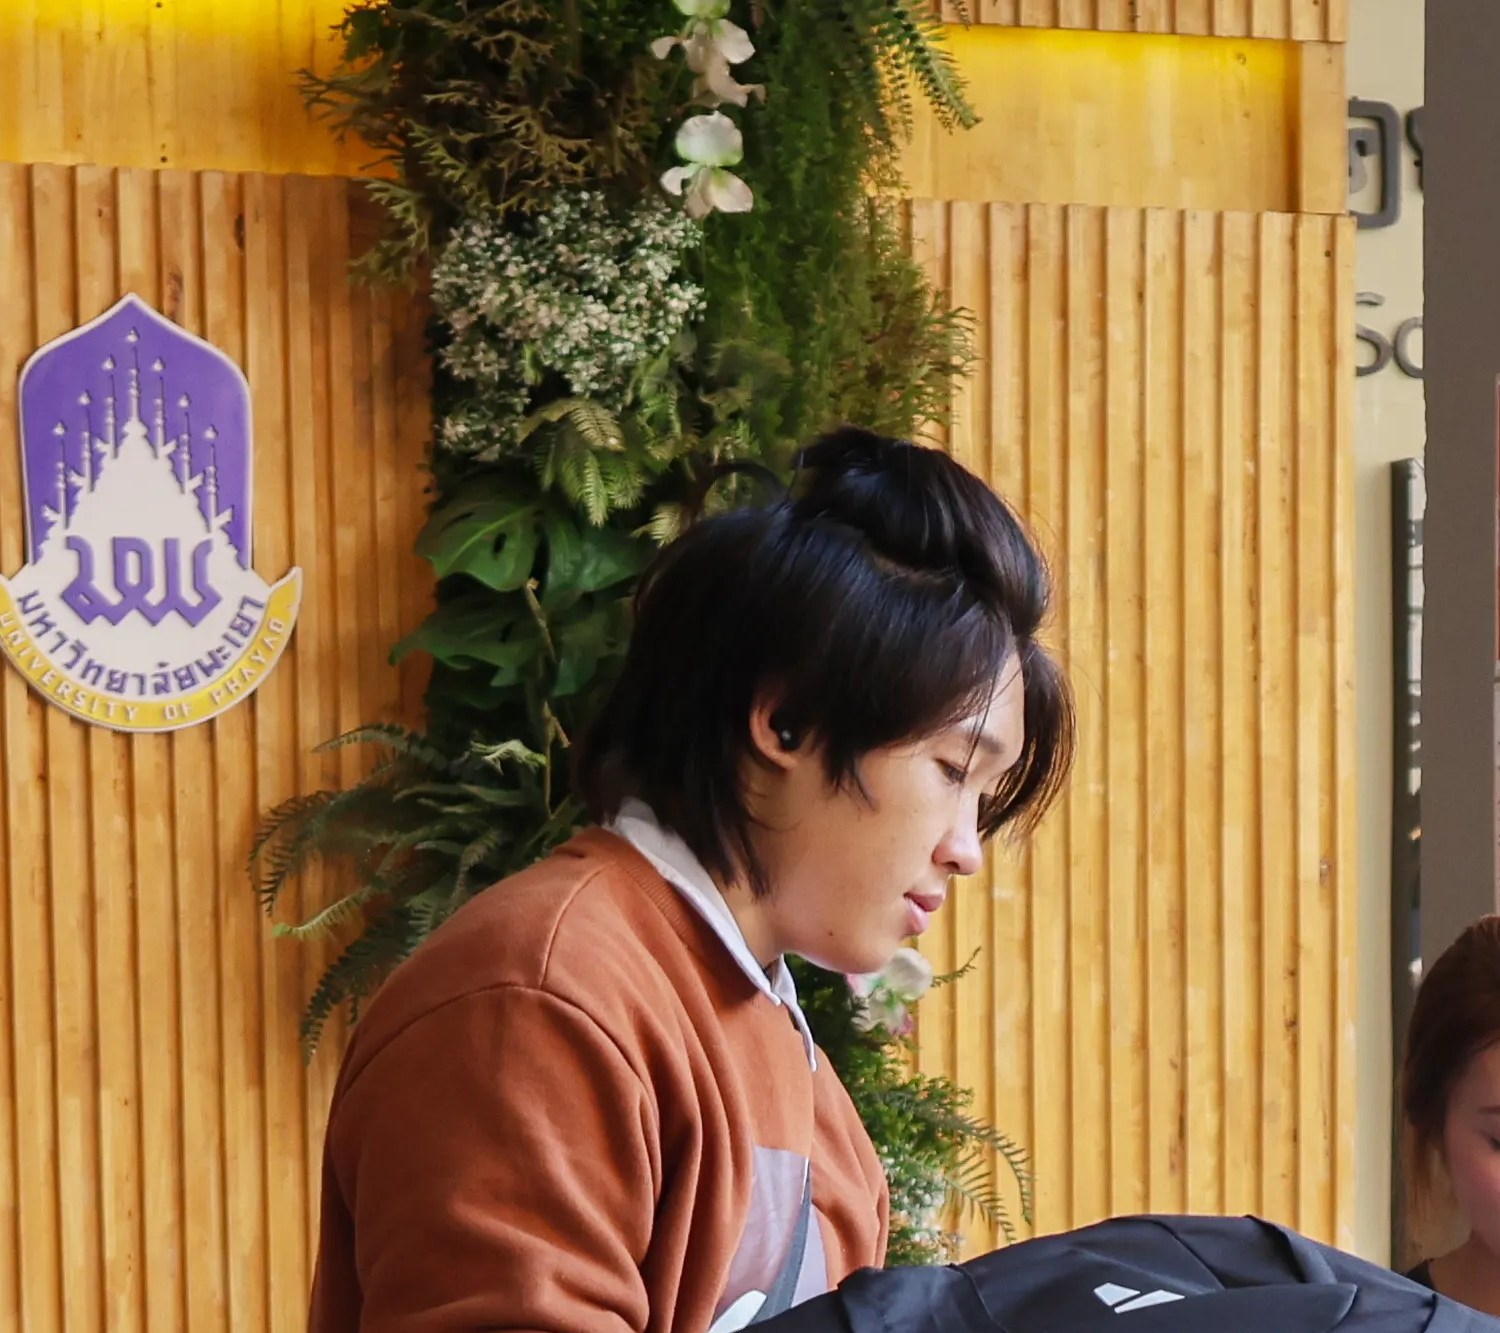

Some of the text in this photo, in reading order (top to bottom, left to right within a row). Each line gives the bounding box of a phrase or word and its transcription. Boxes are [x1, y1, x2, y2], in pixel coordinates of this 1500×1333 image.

[17, 589, 267, 697] มหาวิทยาลัยพะเยา
[162, 699, 195, 722] OF
[209, 616, 286, 705] PHAYAO
